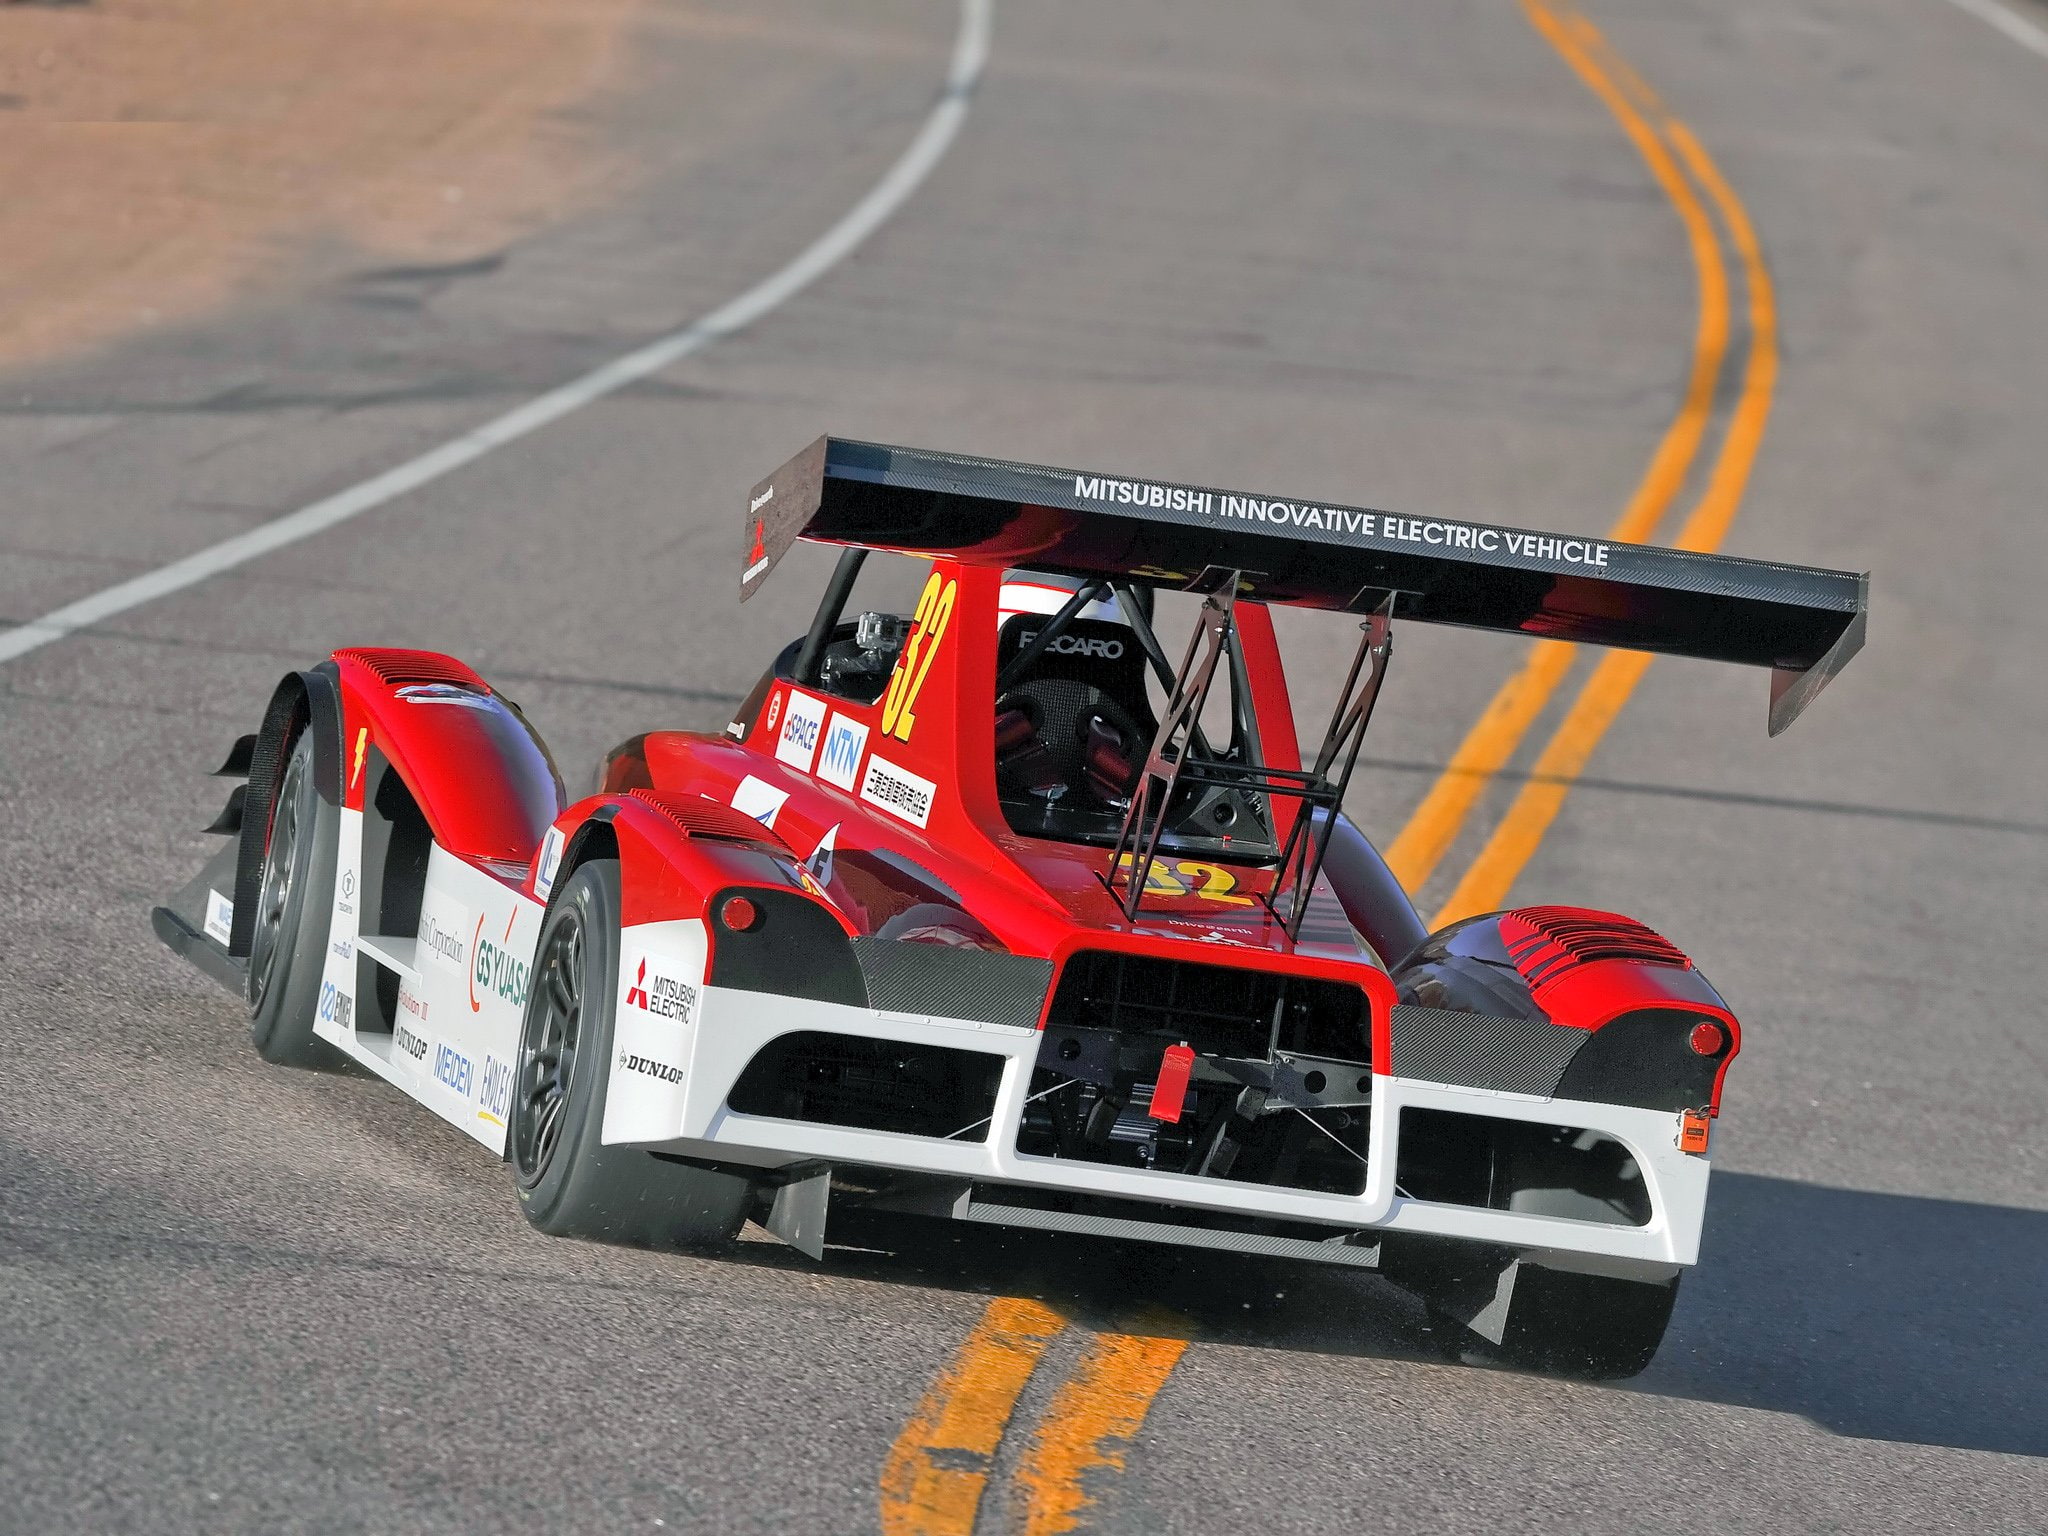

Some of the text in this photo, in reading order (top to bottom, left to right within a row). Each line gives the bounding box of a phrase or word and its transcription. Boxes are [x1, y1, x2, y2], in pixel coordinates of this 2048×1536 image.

[1074, 476, 1609, 567] MITSUBISHI INNOVATIVE ELECTRIC VEHICLE
[881, 571, 957, 745] 32
[784, 713, 818, 750] dSPACE
[824, 725, 862, 778] NTN
[649, 994, 690, 1025] ELECTRIC
[397, 1025, 428, 1061] DUNLOP
[433, 1043, 475, 1098] MEIDEN
[627, 1054, 684, 1085] DUNLOP
